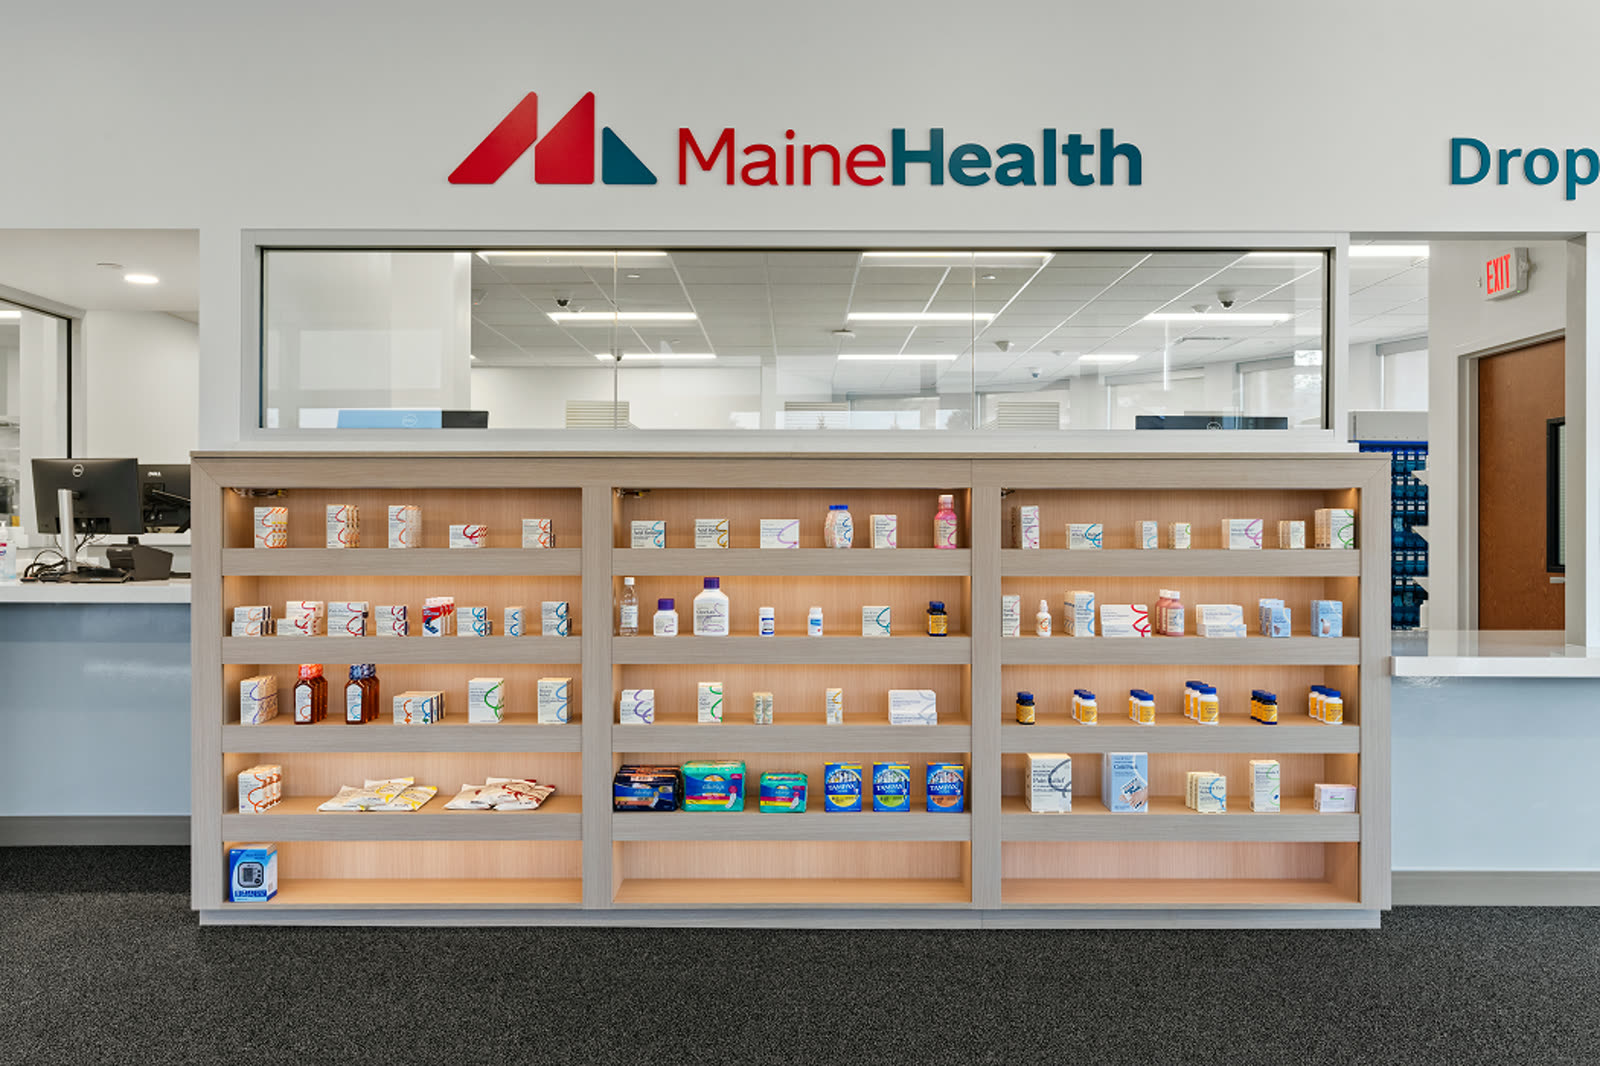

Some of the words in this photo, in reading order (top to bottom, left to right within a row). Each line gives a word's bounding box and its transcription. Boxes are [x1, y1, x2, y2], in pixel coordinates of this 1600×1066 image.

[678, 127, 1142, 187] MaineHealth
[1450, 137, 1600, 201] Drop
[1486, 253, 1511, 295] EXIT
[1048, 776, 1066, 784] elief
[828, 783, 856, 792] TAMPAX
[876, 784, 904, 792] TAMPAX
[929, 784, 958, 792] TAMPAX
